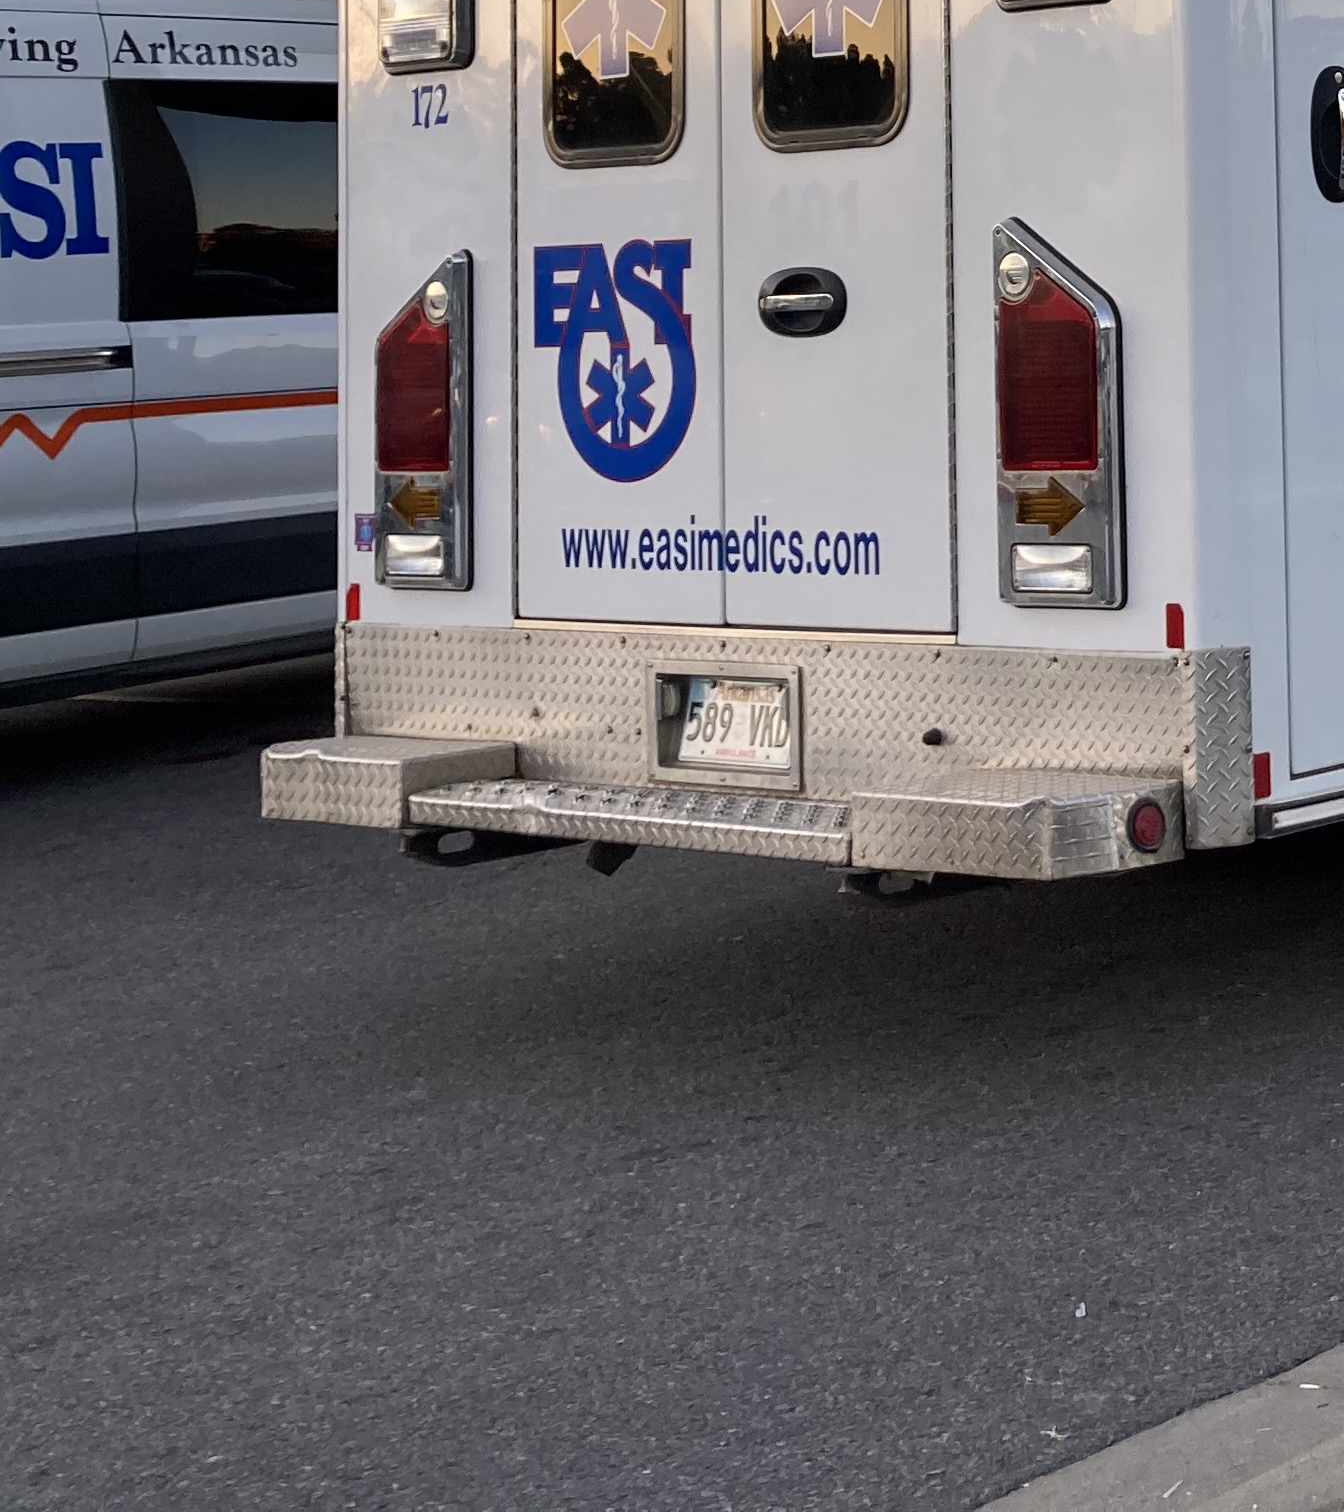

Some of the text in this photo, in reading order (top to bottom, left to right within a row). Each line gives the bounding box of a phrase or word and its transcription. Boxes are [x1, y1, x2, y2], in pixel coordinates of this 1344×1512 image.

[0, 26, 298, 72] ing Arkansas
[411, 83, 449, 129] 172
[561, 514, 880, 575] www.easimedics.com
[686, 701, 790, 748] 589 VKD
